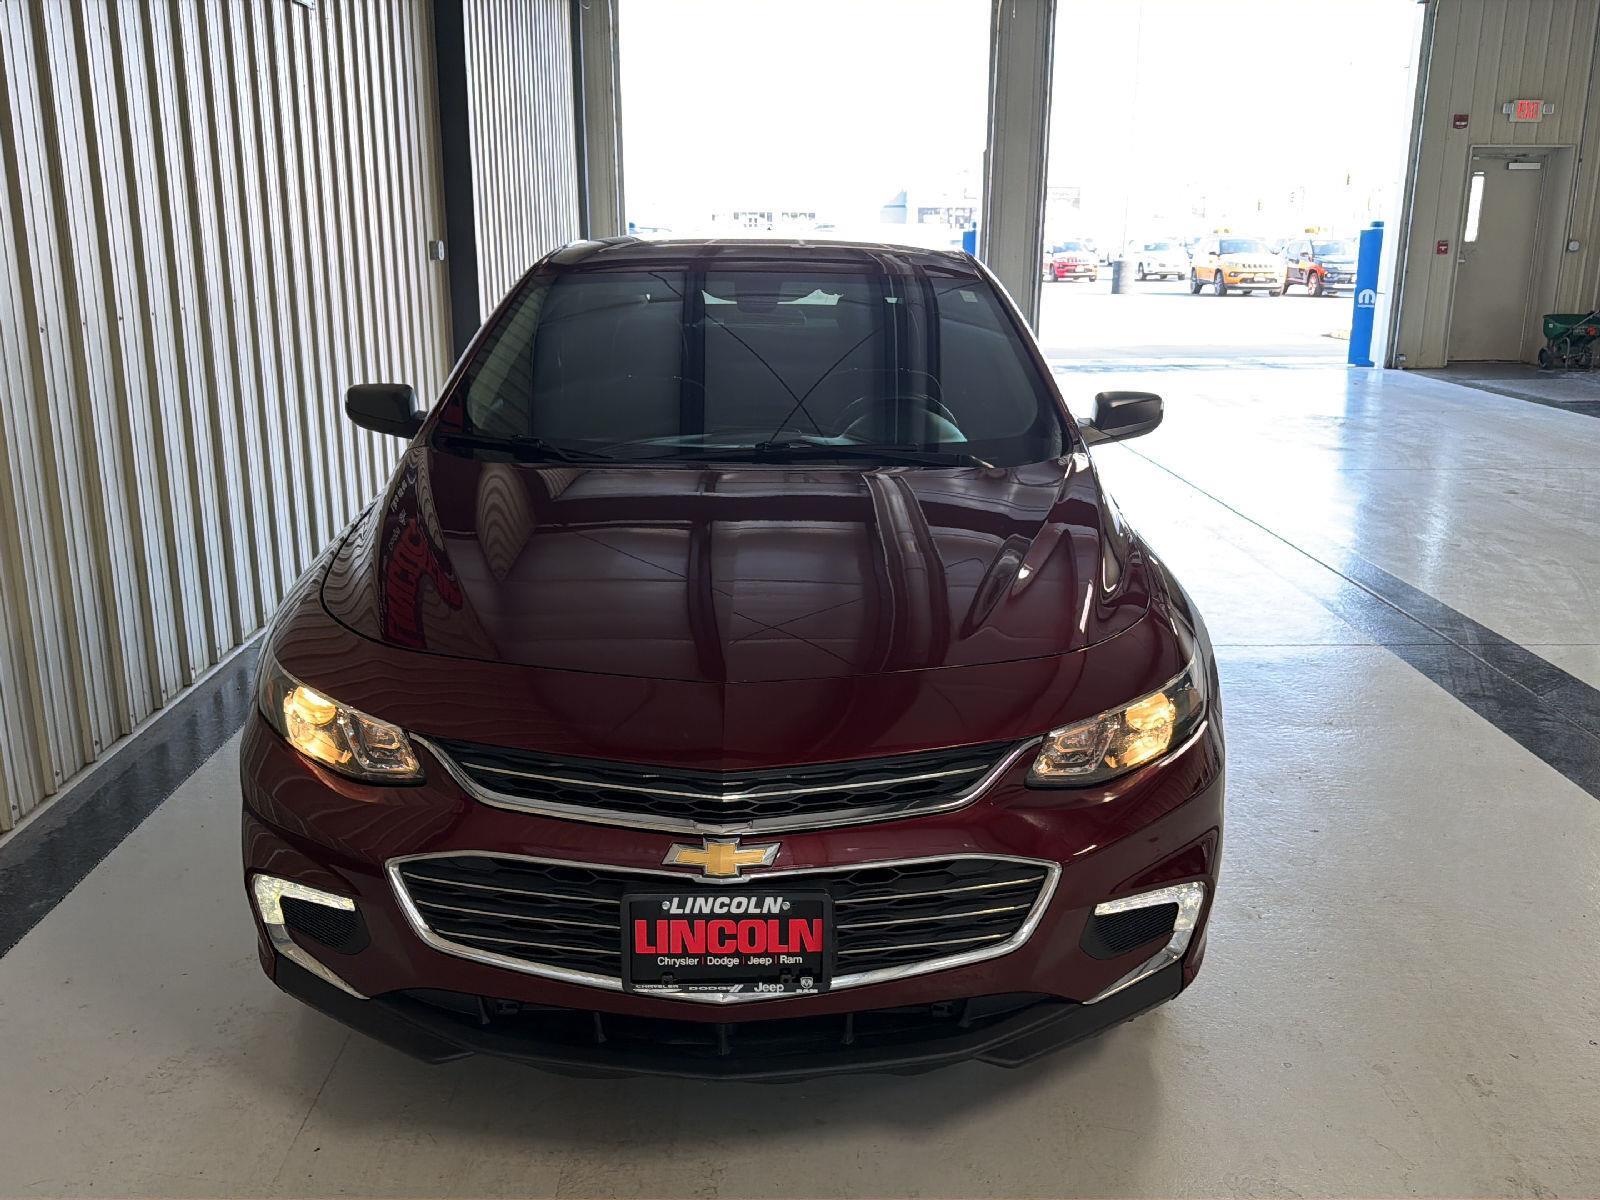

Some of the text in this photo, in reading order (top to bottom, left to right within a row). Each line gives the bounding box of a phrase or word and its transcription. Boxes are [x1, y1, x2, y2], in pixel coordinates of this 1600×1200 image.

[1517, 100, 1541, 119] EXIT
[669, 896, 784, 914] LINCOLN
[634, 919, 823, 954] LINCOLN
[657, 954, 803, 967] Chrysler Dodge Jeep Ram
[753, 981, 785, 993] Jeep
